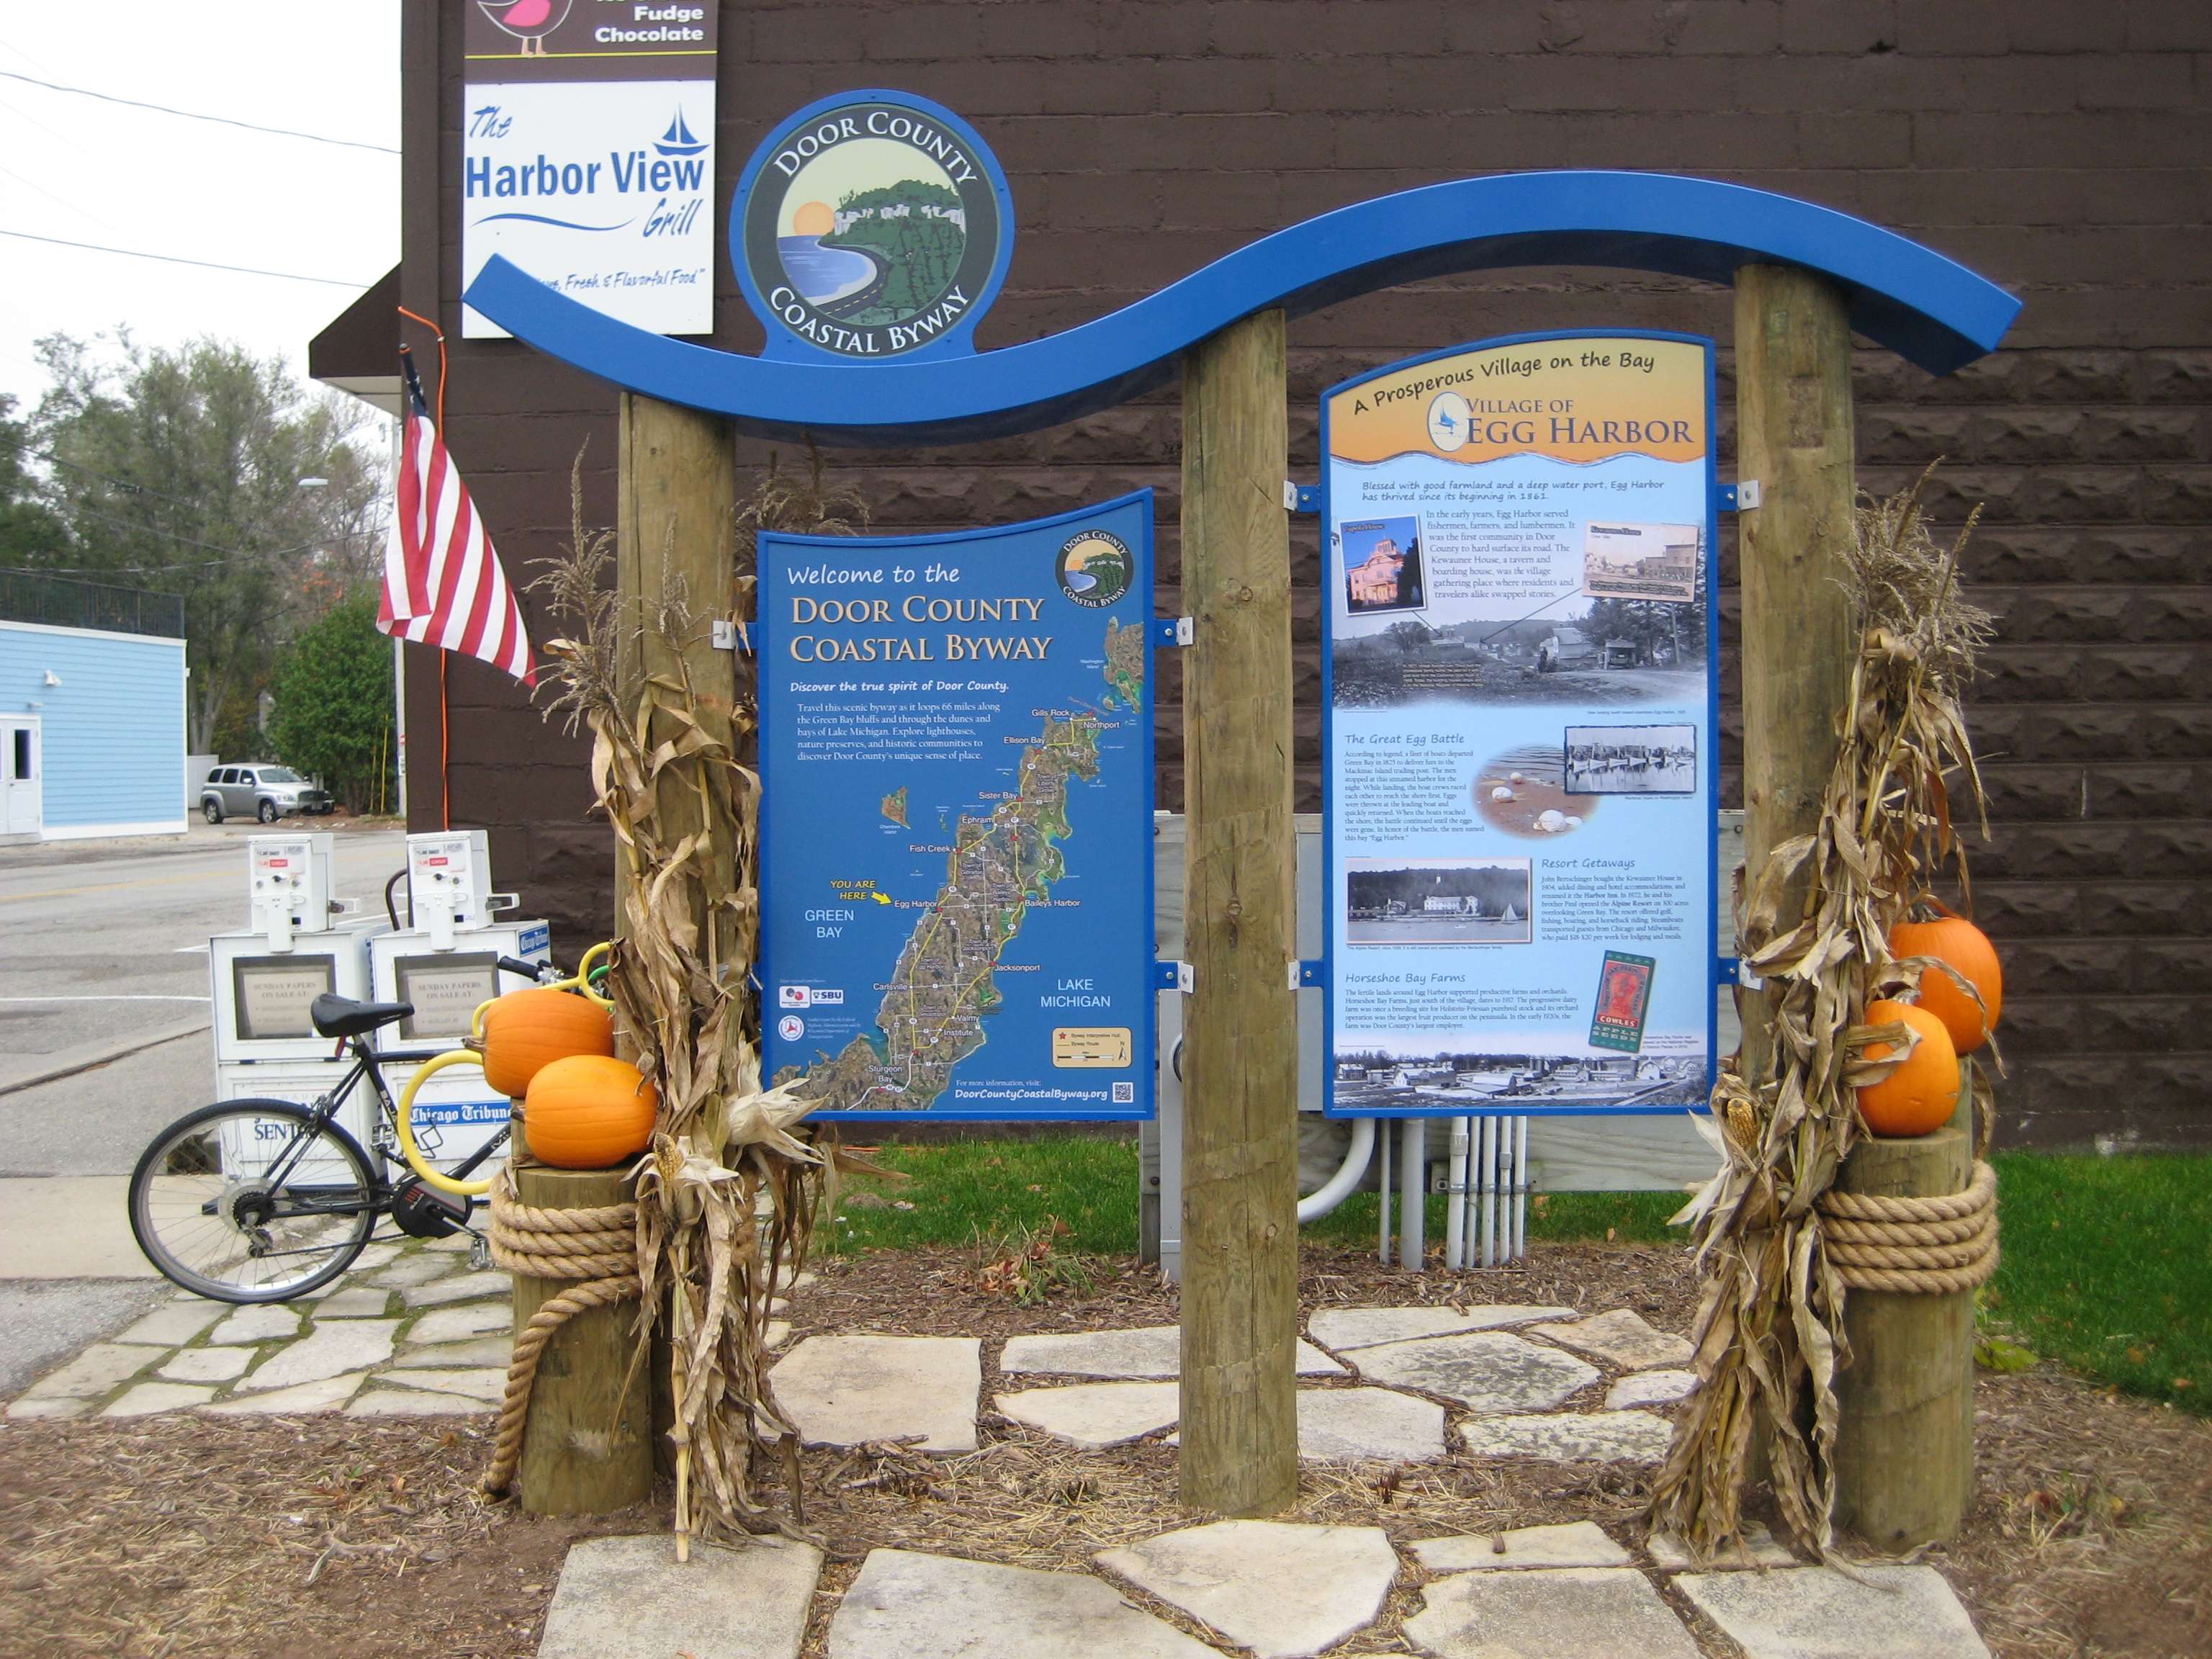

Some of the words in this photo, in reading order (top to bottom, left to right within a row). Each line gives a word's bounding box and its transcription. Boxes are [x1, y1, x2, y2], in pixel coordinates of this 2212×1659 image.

[634, 6, 703, 23] Fudge
[595, 27, 703, 42] Chocolate
[469, 106, 513, 138] The
[773, 118, 861, 177] DOOR
[867, 112, 978, 184] COUNTY
[467, 154, 601, 197] Harbor
[611, 151, 705, 192] View
[643, 198, 703, 237] Grill
[565, 274, 600, 290] Fresh
[603, 274, 613, 287] &
[613, 271, 670, 287] Flavorful
[770, 287, 880, 353] COASTAL
[887, 286, 969, 351] BYWAY
[1354, 400, 1369, 415] A
[1374, 369, 1474, 407] Prosperous
[1480, 357, 1542, 377] Village
[1550, 357, 1573, 369] on
[1580, 351, 1611, 367] the
[1619, 352, 1655, 373] Bay
[1465, 398, 1543, 413] VILLAGE
[1550, 400, 1573, 413] OF
[1467, 418, 1535, 444] EGG
[1549, 418, 1695, 444] HARBOR
[1399, 481, 1420, 490] with
[1424, 482, 1445, 491] good
[1449, 480, 1493, 490] farmland
[1497, 480, 1514, 489] and
[1527, 480, 1548, 491] deep
[1611, 481, 1627, 491] Egg
[1631, 480, 1665, 489] Harbor
[1381, 493, 1414, 501] thrived
[1460, 492, 1503, 503] beginning
[1063, 533, 1090, 552] DOOR
[1092, 531, 1128, 554] COUNTY
[788, 564, 884, 584] Welcome
[894, 566, 914, 583] to
[925, 563, 960, 583] the
[1063, 586, 1099, 607] COASTAL
[1100, 586, 1126, 606] BYWAY
[792, 597, 894, 623] DOOR
[903, 595, 1045, 622] COUNTY
[790, 635, 934, 662] COASTAL
[945, 634, 1053, 660] BYWAY
[791, 682, 836, 692] Discover
[839, 681, 857, 691] the
[861, 682, 884, 691] true
[889, 682, 918, 693] spirit
[922, 680, 933, 691] of
[937, 681, 963, 691] Door
[968, 681, 1010, 693] County.
[870, 703, 896, 714] byway
[918, 703, 940, 713] loops
[978, 703, 1000, 713] along
[840, 716, 853, 726] Bay
[899, 715, 931, 725] through
[798, 728, 817, 738] bays
[850, 728, 890, 737] Michigan.
[892, 727, 924, 737] Explore
[927, 727, 976, 737] lighthouses,
[1344, 734, 1364, 744] The
[1370, 734, 1401, 744] Great
[1406, 734, 1426, 746] Egg
[1431, 734, 1465, 744] Battle
[894, 752, 922, 762] unique
[959, 752, 982, 761] place.
[1003, 792, 1017, 801] Bay
[962, 817, 993, 825] Ephraim
[1542, 858, 1578, 868] Resort
[1582, 858, 1635, 870] Getaways
[894, 900, 909, 909] Egg
[1025, 899, 1052, 908] Baileys
[805, 910, 854, 922] GREEN
[817, 927, 842, 938] BAY
[1346, 973, 1401, 983] Horseshoe
[1405, 973, 1426, 984] Bay
[1431, 974, 1465, 983] Farms
[1058, 979, 1094, 991] LAKE
[1040, 997, 1111, 1007] MICHIGAN
[1600, 1015, 1635, 1027] COWLES
[878, 1075, 894, 1084] Bay
[955, 1089, 1107, 1101] DoorCountyCoastalByway.org
[410, 1107, 458, 1123] Chicago
